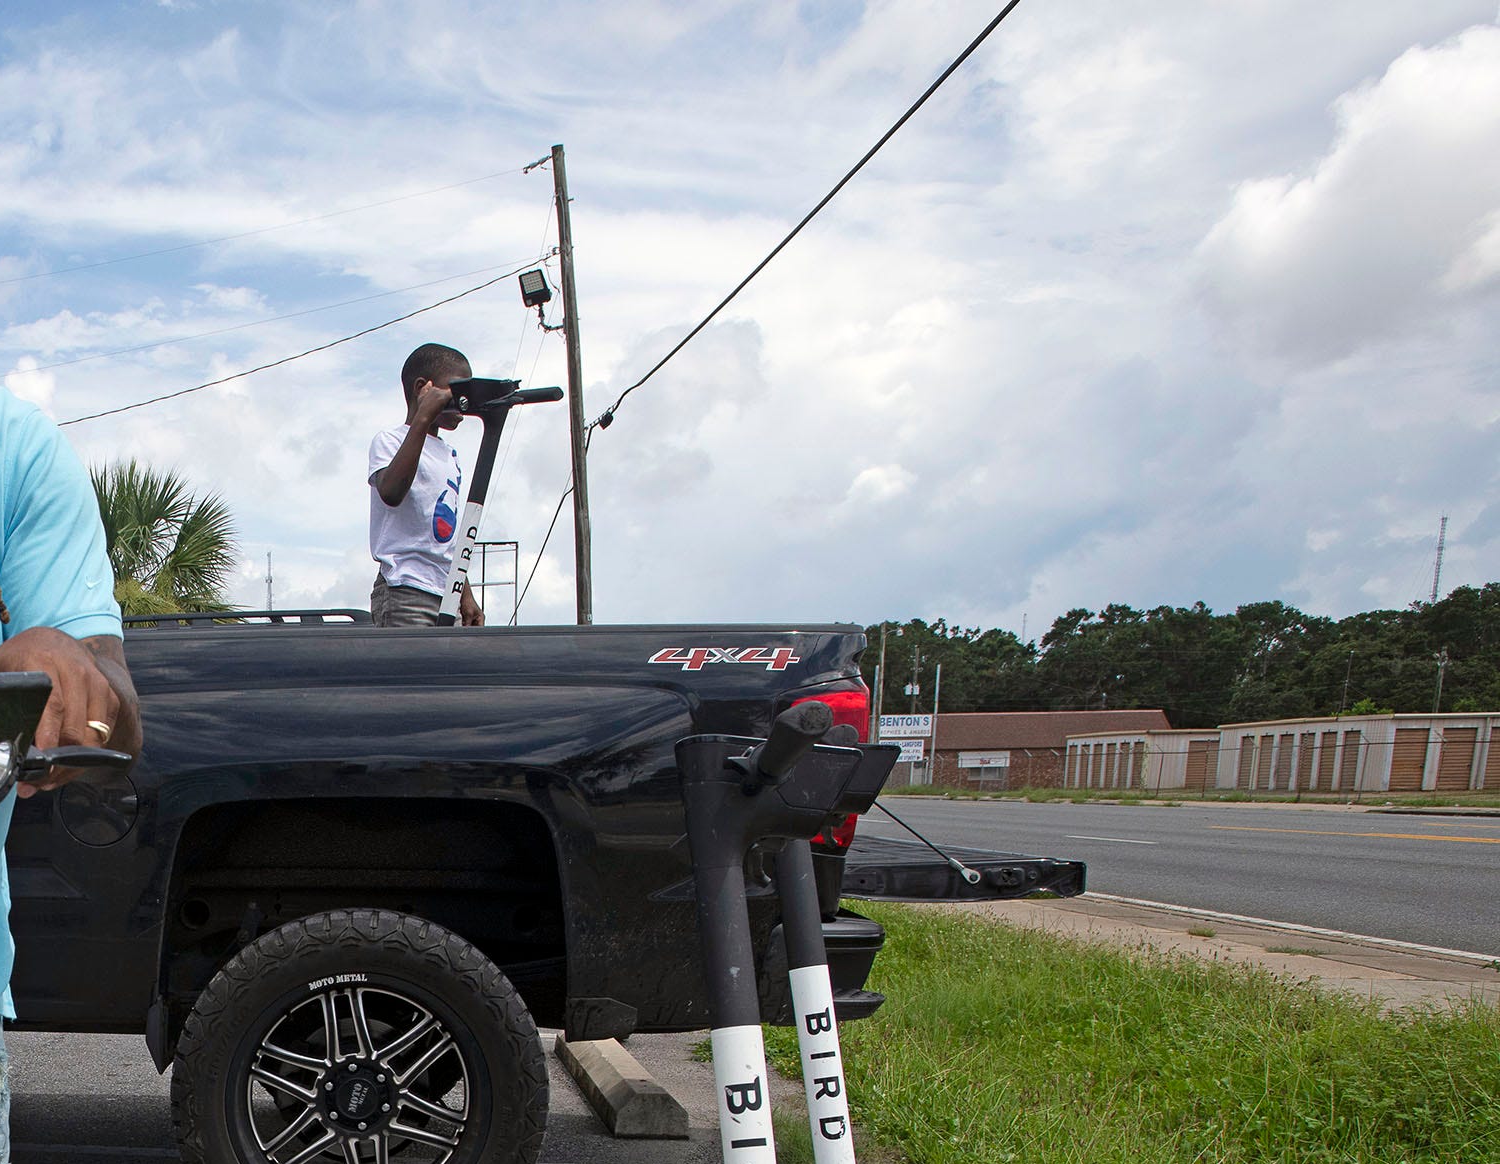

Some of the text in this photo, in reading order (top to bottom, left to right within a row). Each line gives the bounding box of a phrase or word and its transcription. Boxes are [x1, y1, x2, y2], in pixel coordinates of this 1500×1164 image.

[452, 526, 477, 593] BIRD
[308, 973, 368, 990] MOTO METAL
[805, 1007, 846, 1140] BIRD
[348, 1083, 362, 1113] MOTO
